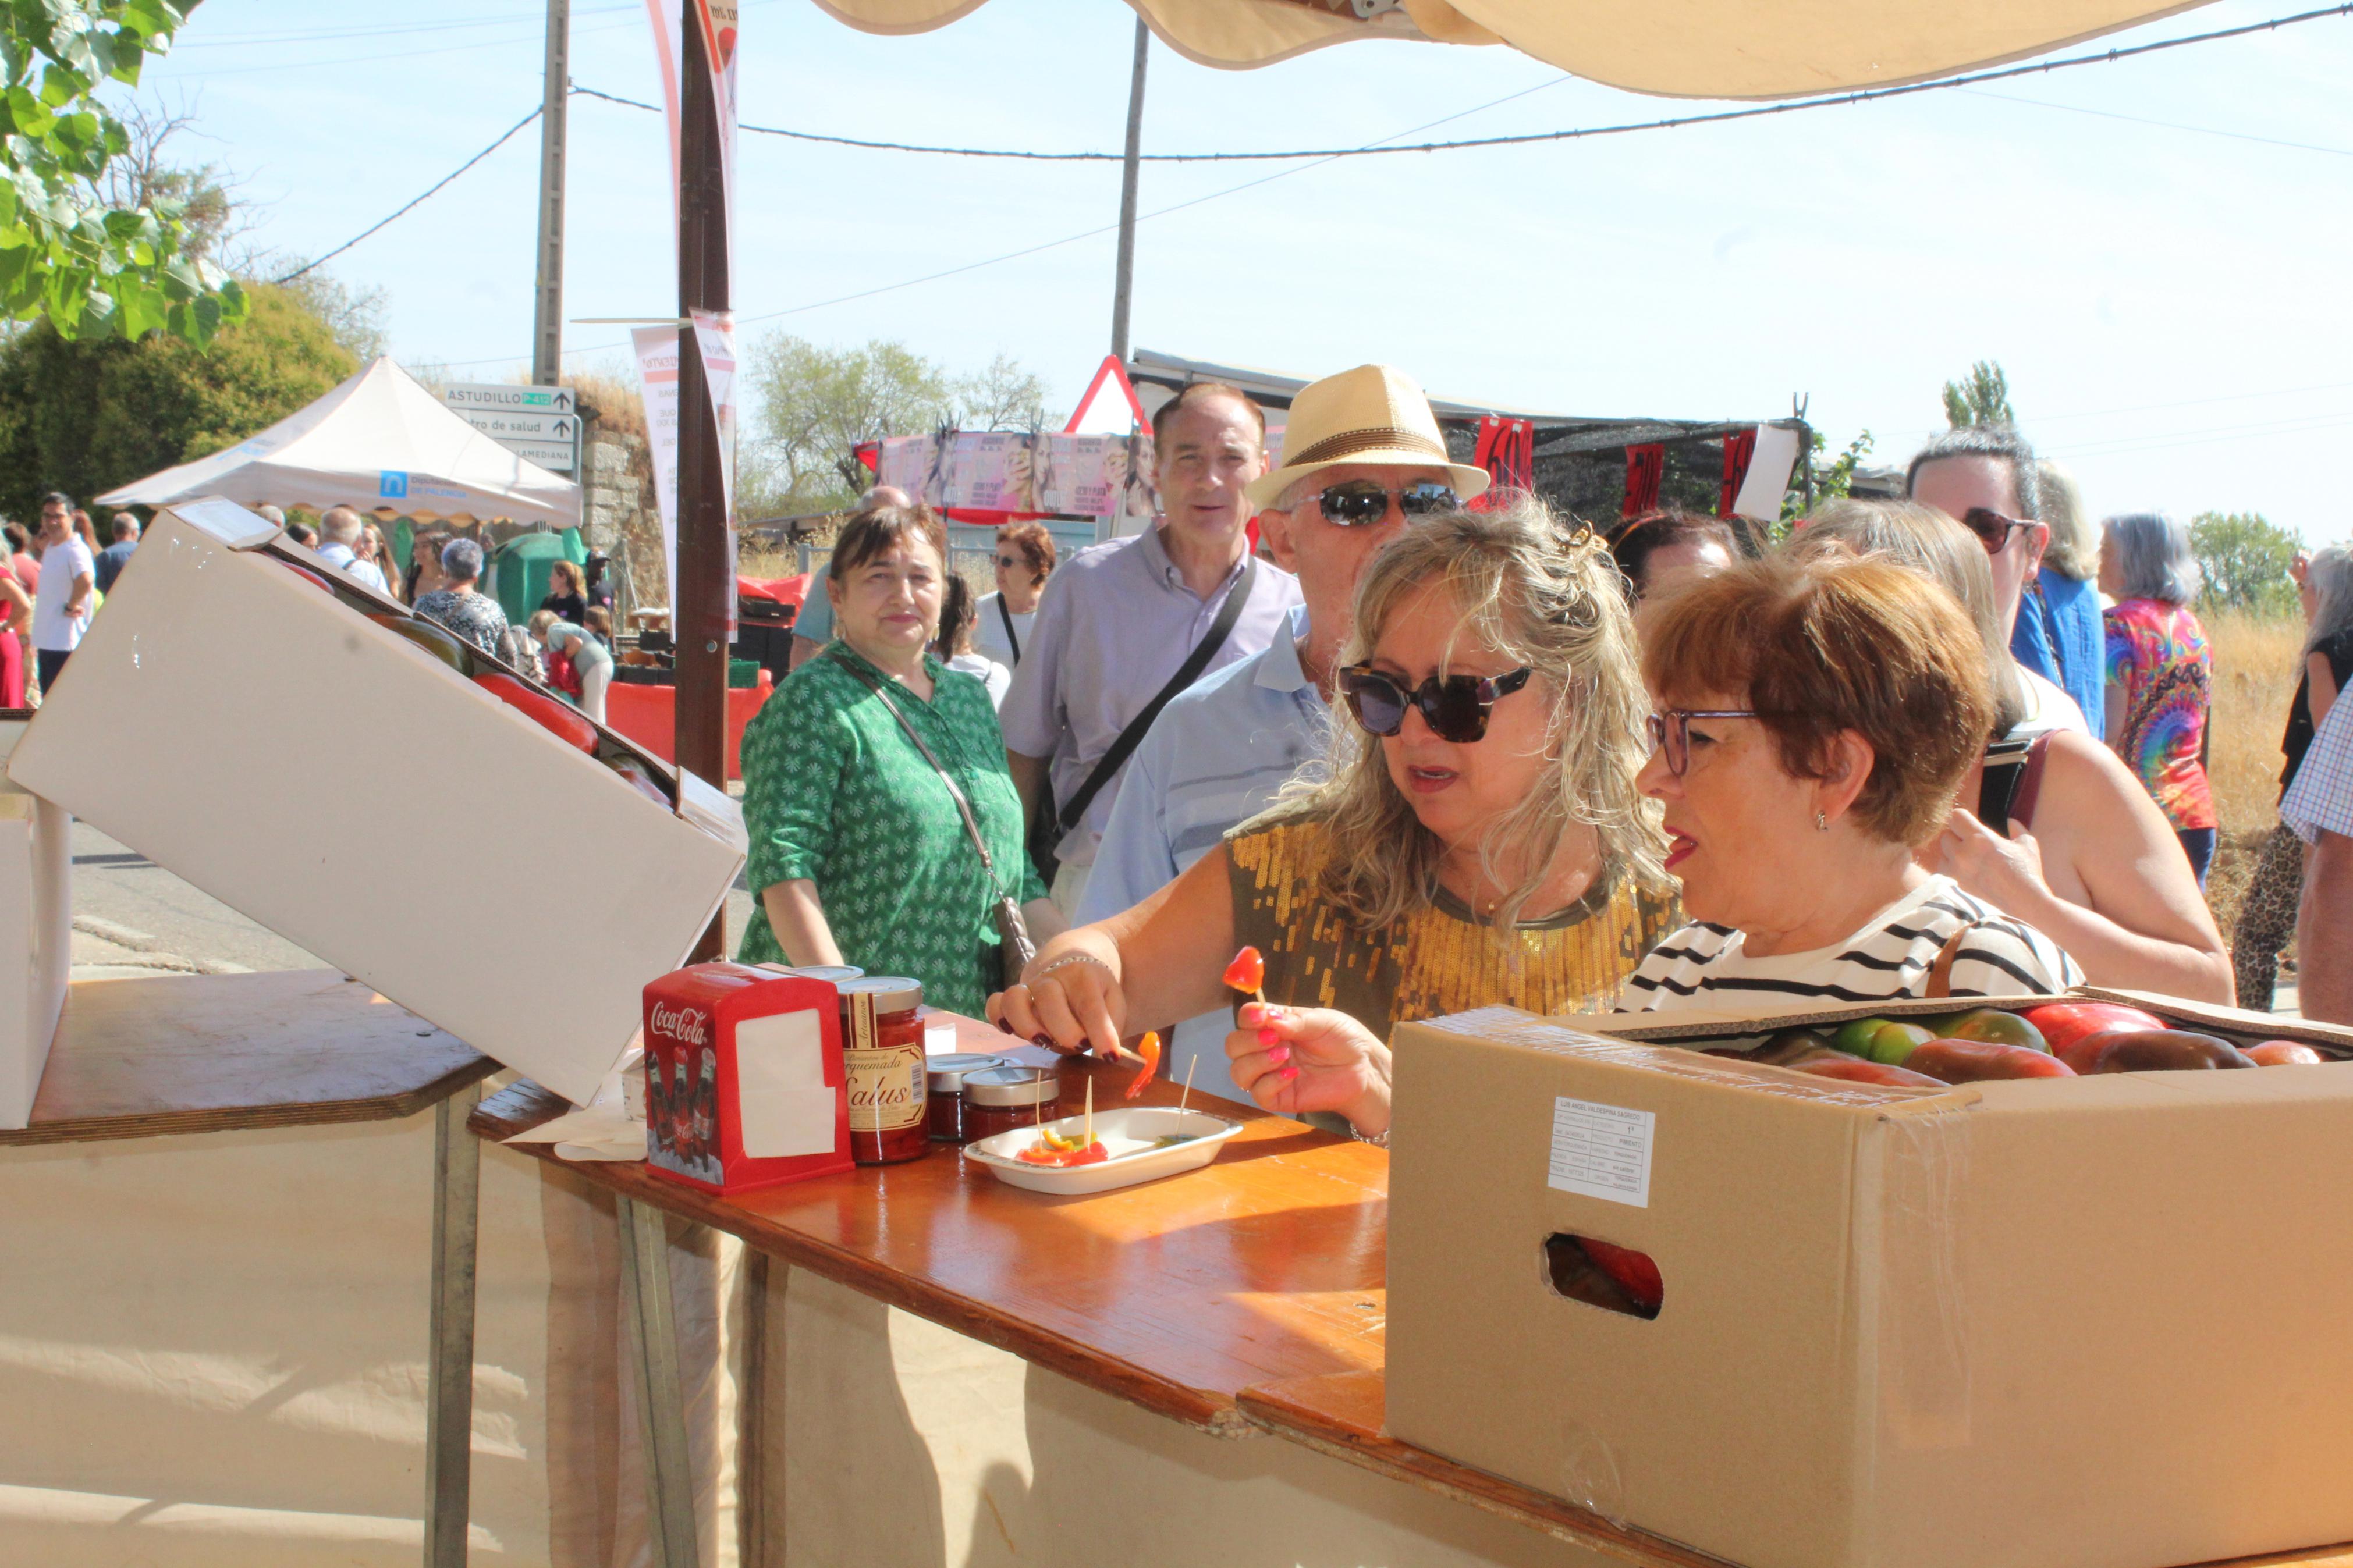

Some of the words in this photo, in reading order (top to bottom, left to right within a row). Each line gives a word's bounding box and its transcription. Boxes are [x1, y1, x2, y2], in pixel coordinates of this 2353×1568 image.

[448, 390, 521, 404] ASTUDILLO
[523, 393, 551, 404] P-412
[492, 420, 505, 430] de
[510, 421, 541, 432] salud
[425, 488, 466, 498] PALENCIA
[651, 1001, 707, 1045] Coca-Cola
[845, 1055, 903, 1074] rquemada
[1571, 1102, 1587, 1111] ANGEL
[1588, 1105, 1616, 1116] VALDESPINA
[1617, 1111, 1641, 1121] SAGREDO
